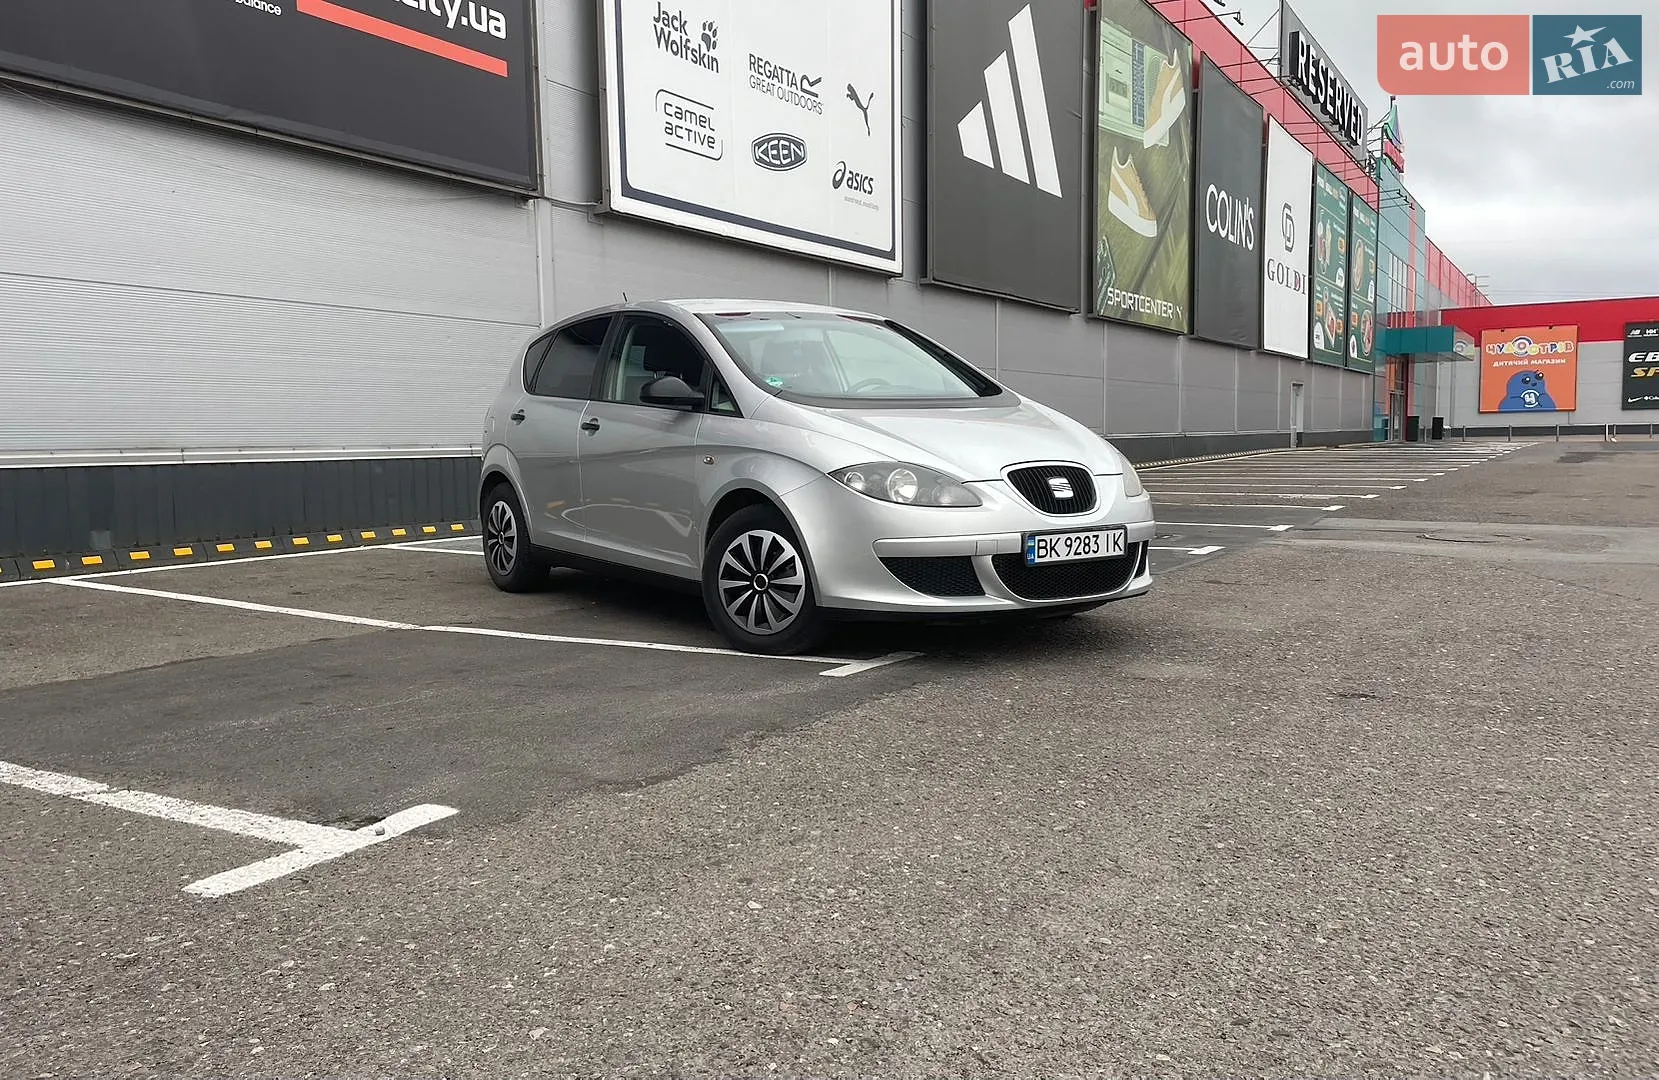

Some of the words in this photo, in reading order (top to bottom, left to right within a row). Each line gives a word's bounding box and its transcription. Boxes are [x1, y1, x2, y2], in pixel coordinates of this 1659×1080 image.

[653, 1, 688, 37] Jack
[653, 23, 719, 74] Wolfskin
[749, 53, 798, 91] REGATTA
[1297, 30, 1364, 147] RESERVED
[749, 74, 776, 97] GREAT
[777, 86, 823, 116] OUTDOORS
[755, 139, 804, 165] KEEN
[846, 170, 874, 195] asics
[1206, 183, 1255, 252] COLIN'S
[1267, 258, 1307, 296] GOLDI
[1107, 287, 1174, 319] SPORTCENTER
[1530, 357, 1566, 366] МАГАЗИН
[1037, 536, 1061, 558] BK
[1064, 534, 1099, 557] 9283
[1106, 532, 1123, 553] IK
